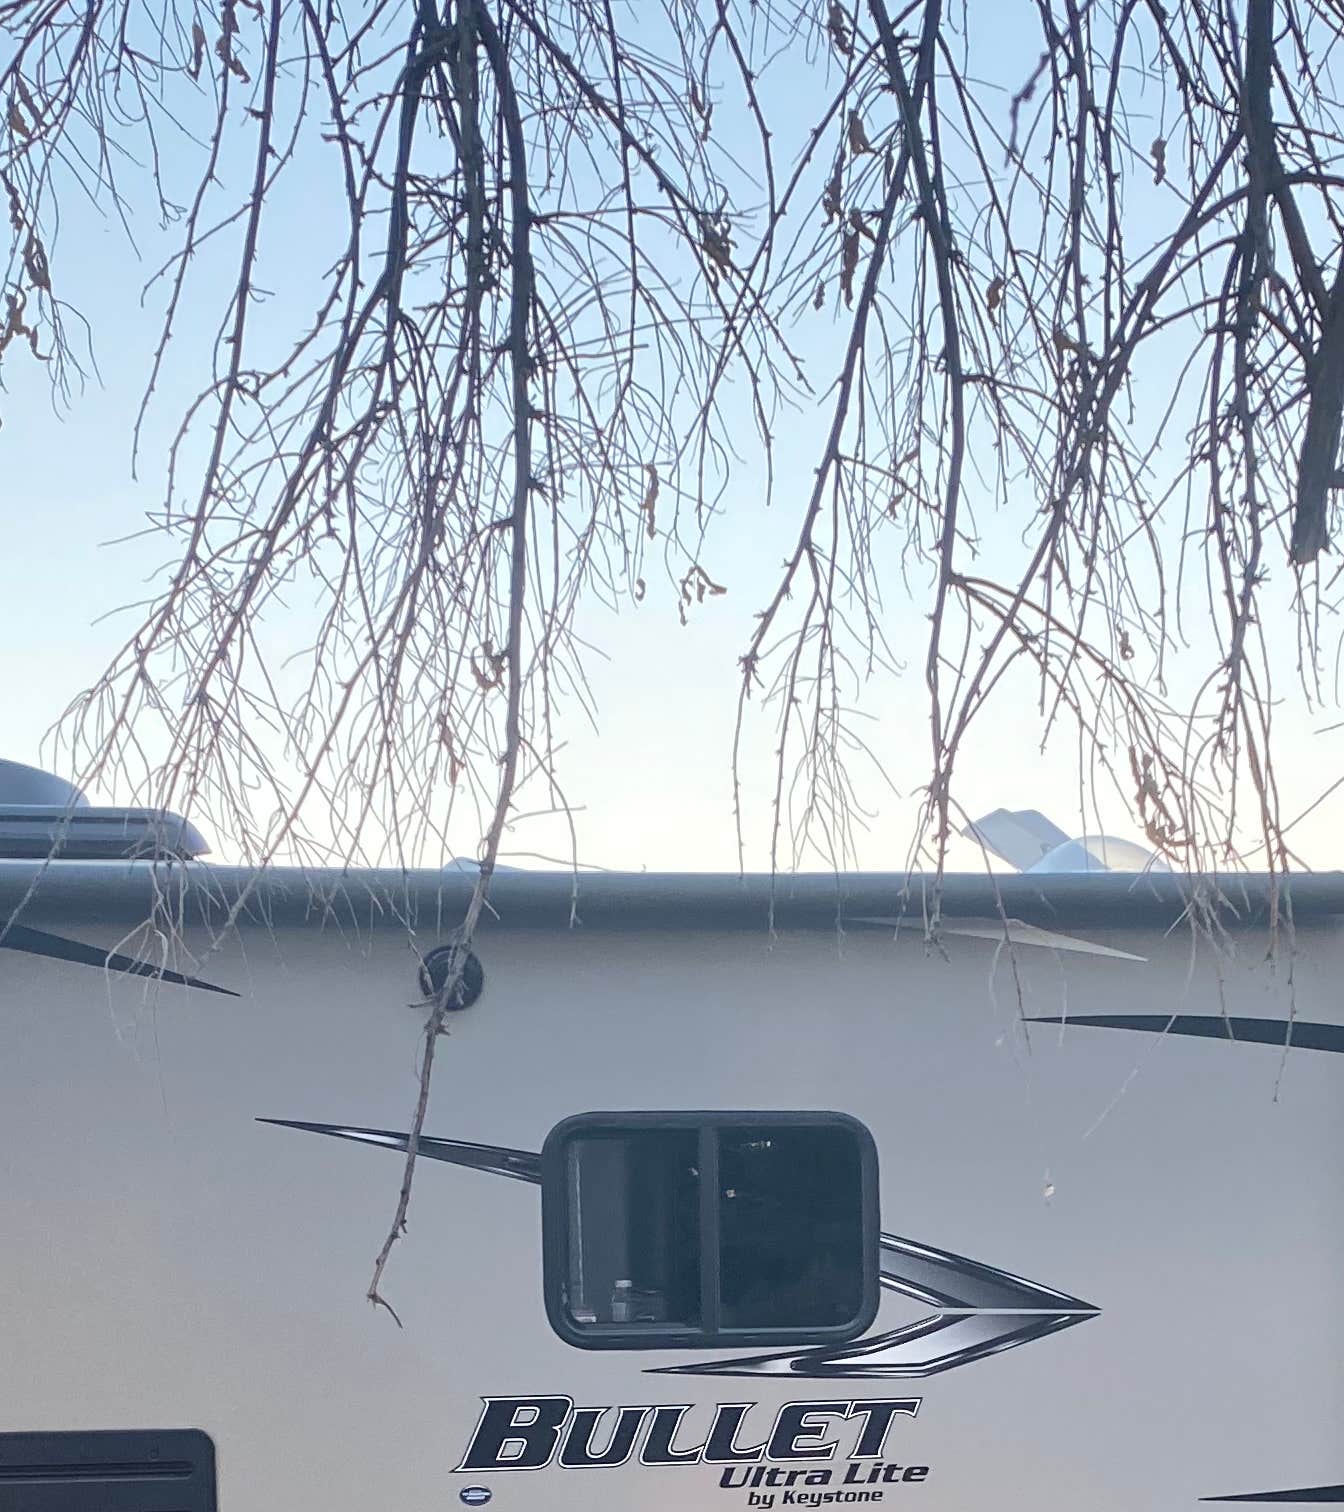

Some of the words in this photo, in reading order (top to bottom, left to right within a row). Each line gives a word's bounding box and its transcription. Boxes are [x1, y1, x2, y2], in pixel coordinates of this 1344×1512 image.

[451, 1394, 923, 1473] BULLET
[719, 1465, 833, 1489] Ultra
[842, 1462, 930, 1485] Lite
[747, 1491, 775, 1510] by
[782, 1490, 884, 1508] Keystone
